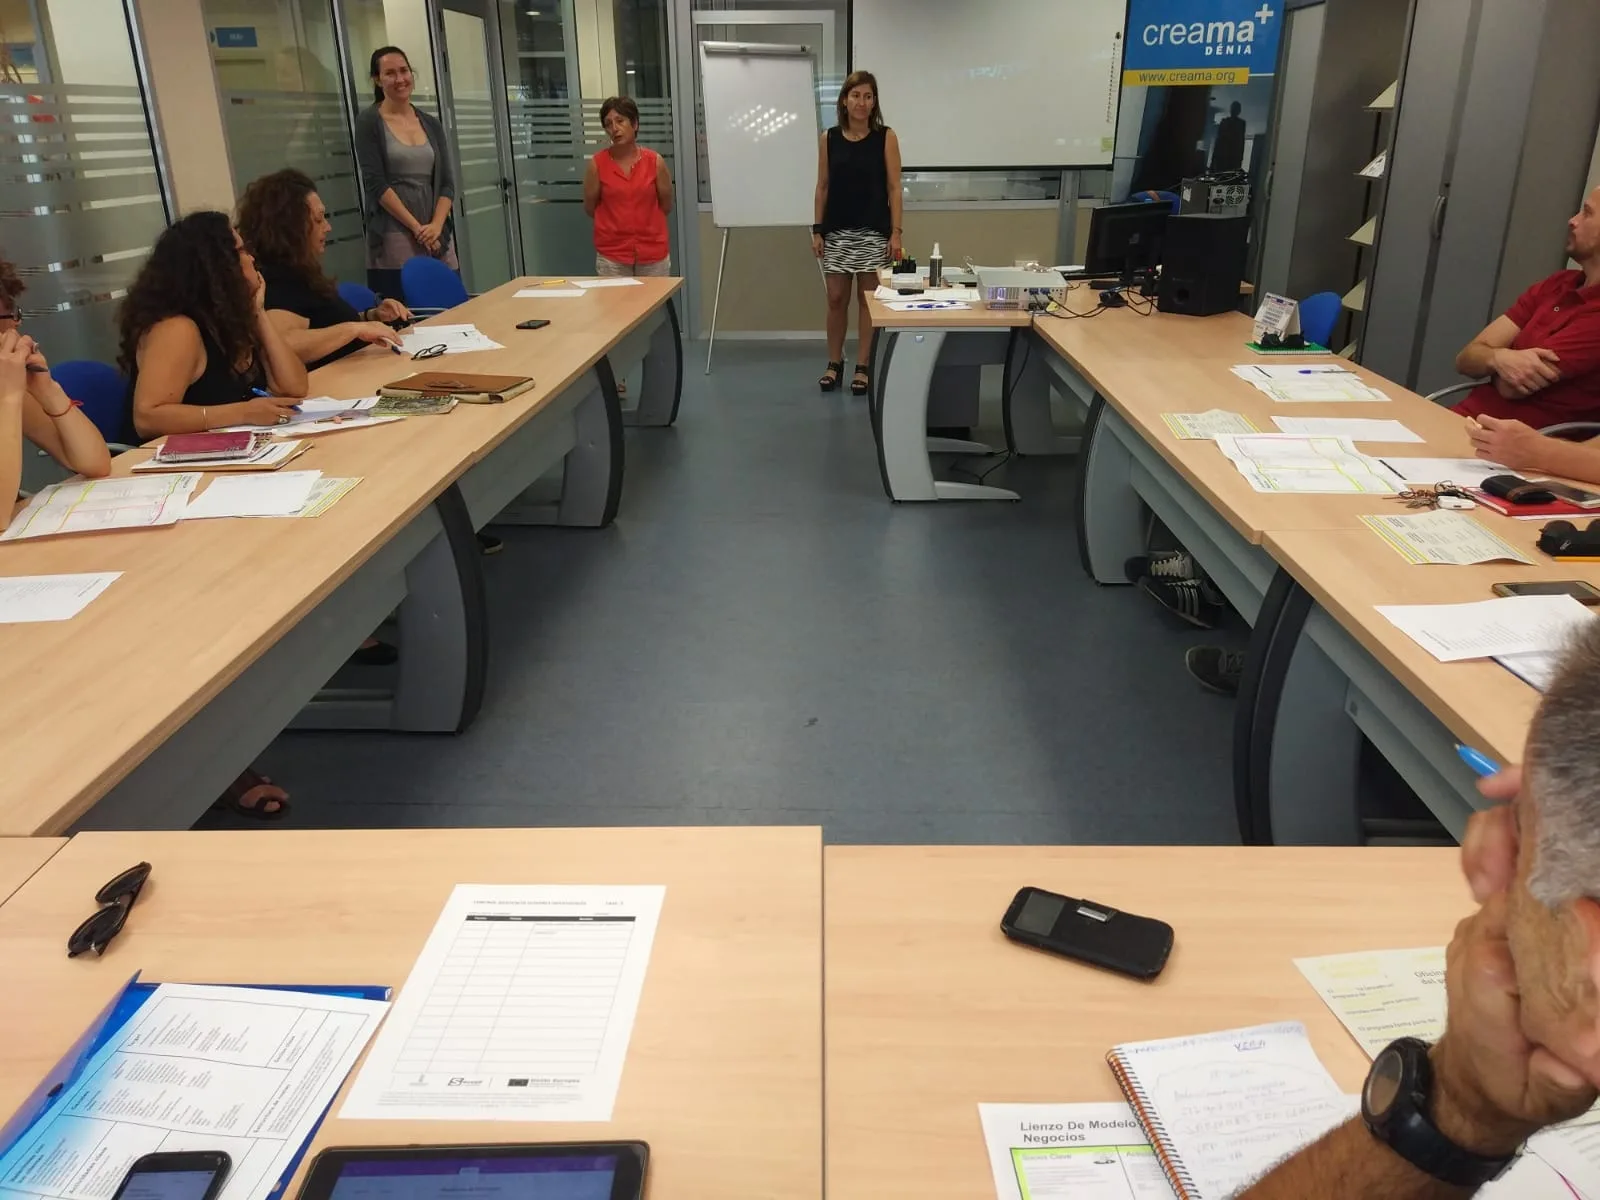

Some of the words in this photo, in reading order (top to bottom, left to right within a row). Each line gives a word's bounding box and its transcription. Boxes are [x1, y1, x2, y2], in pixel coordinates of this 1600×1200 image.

[1205, 45, 1252, 56] DÉNIA
[1139, 70, 1235, 83] www.creama.org
[1020, 1121, 1063, 1131] Lienzo
[1068, 1121, 1085, 1130] De
[1089, 1119, 1137, 1129] Modelo
[1023, 1133, 1086, 1145] Negocios
